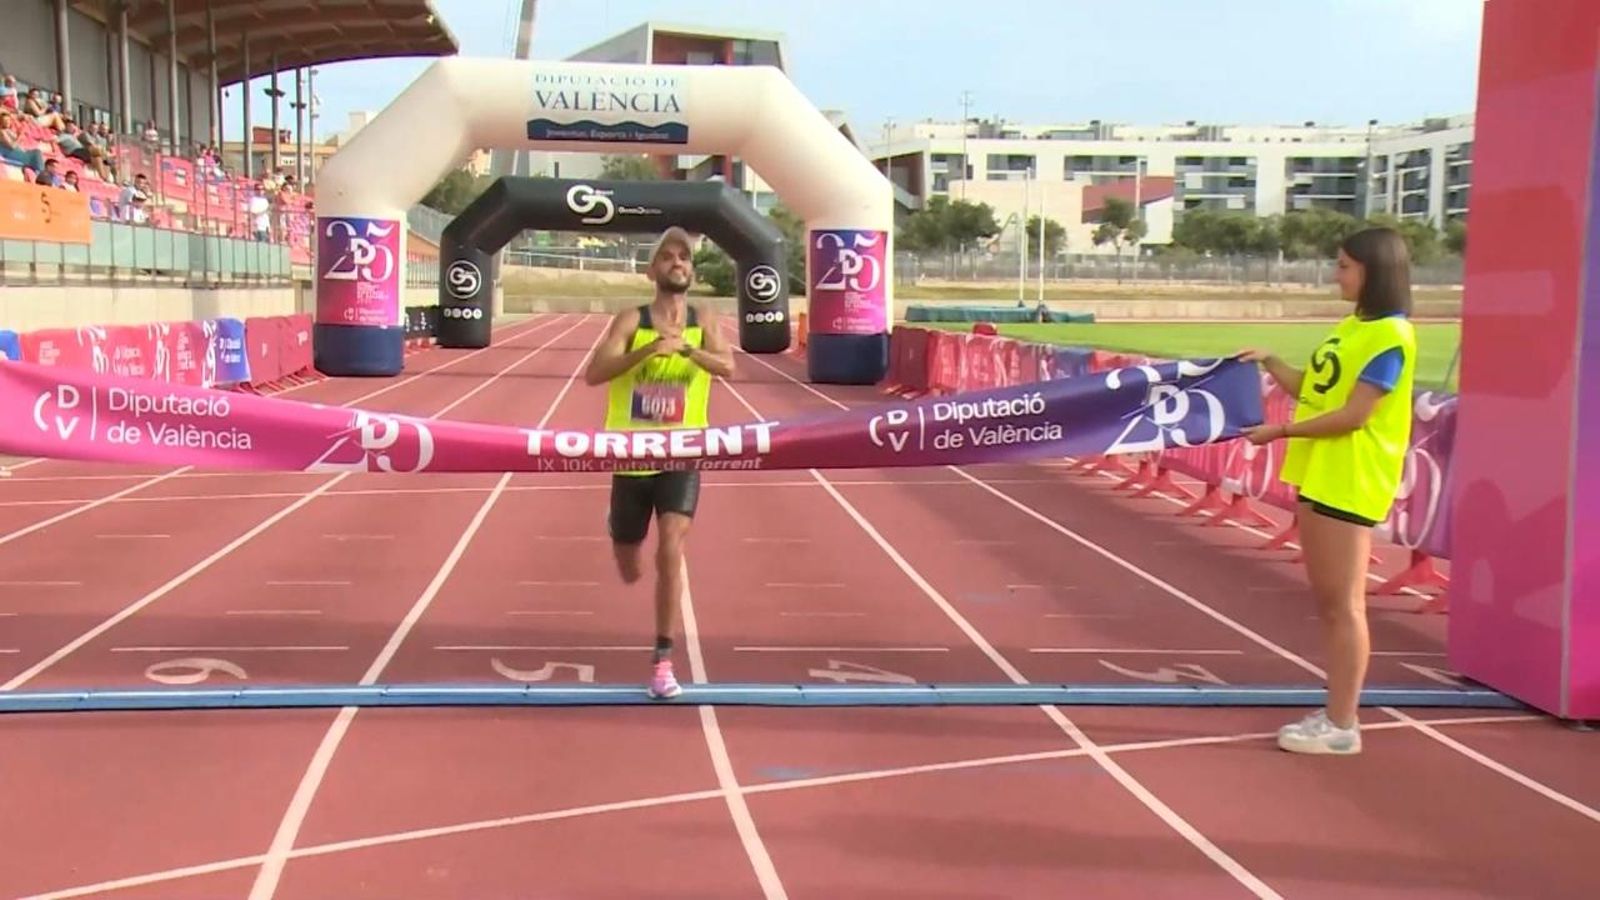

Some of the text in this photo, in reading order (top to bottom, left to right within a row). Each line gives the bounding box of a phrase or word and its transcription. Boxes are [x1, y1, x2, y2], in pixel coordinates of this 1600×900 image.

[108, 387, 231, 418] Diputació
[933, 391, 1046, 425] Diputació
[106, 420, 253, 450] de València
[518, 420, 780, 459] TORRENT
[934, 421, 1063, 451] de València
[537, 456, 763, 472] IX 10K Ciutat de Torrent
